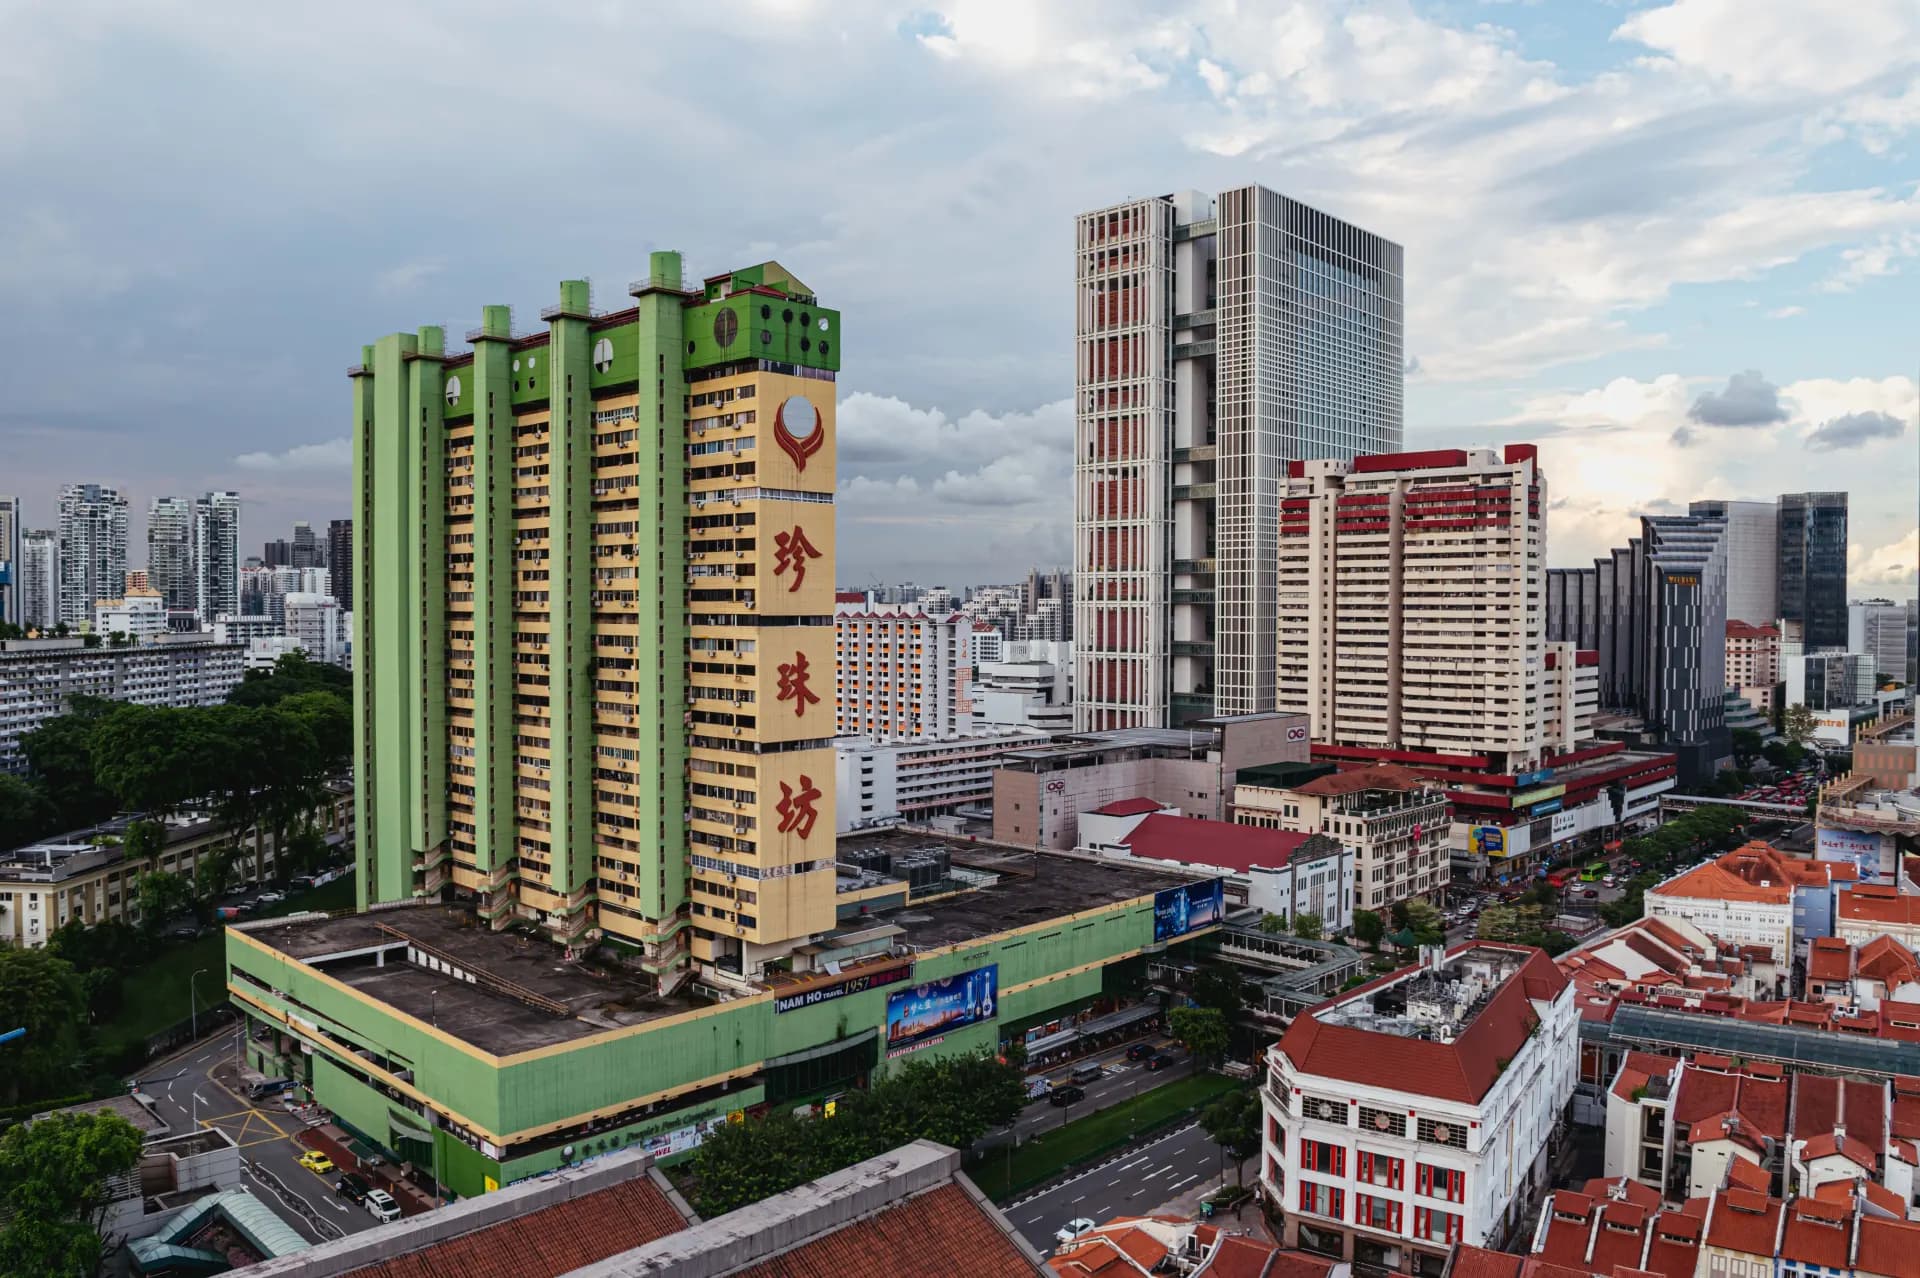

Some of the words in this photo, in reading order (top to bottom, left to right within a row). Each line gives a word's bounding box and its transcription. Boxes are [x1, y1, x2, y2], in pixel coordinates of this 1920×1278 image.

[1287, 729, 1305, 740] OG
[1047, 781, 1064, 791] OG
[780, 996, 804, 1011] NAM
[806, 990, 822, 1004] HO
[823, 989, 844, 999] TRAVEL
[844, 976, 870, 994] 1957
[655, 1146, 672, 1158] AVEL
